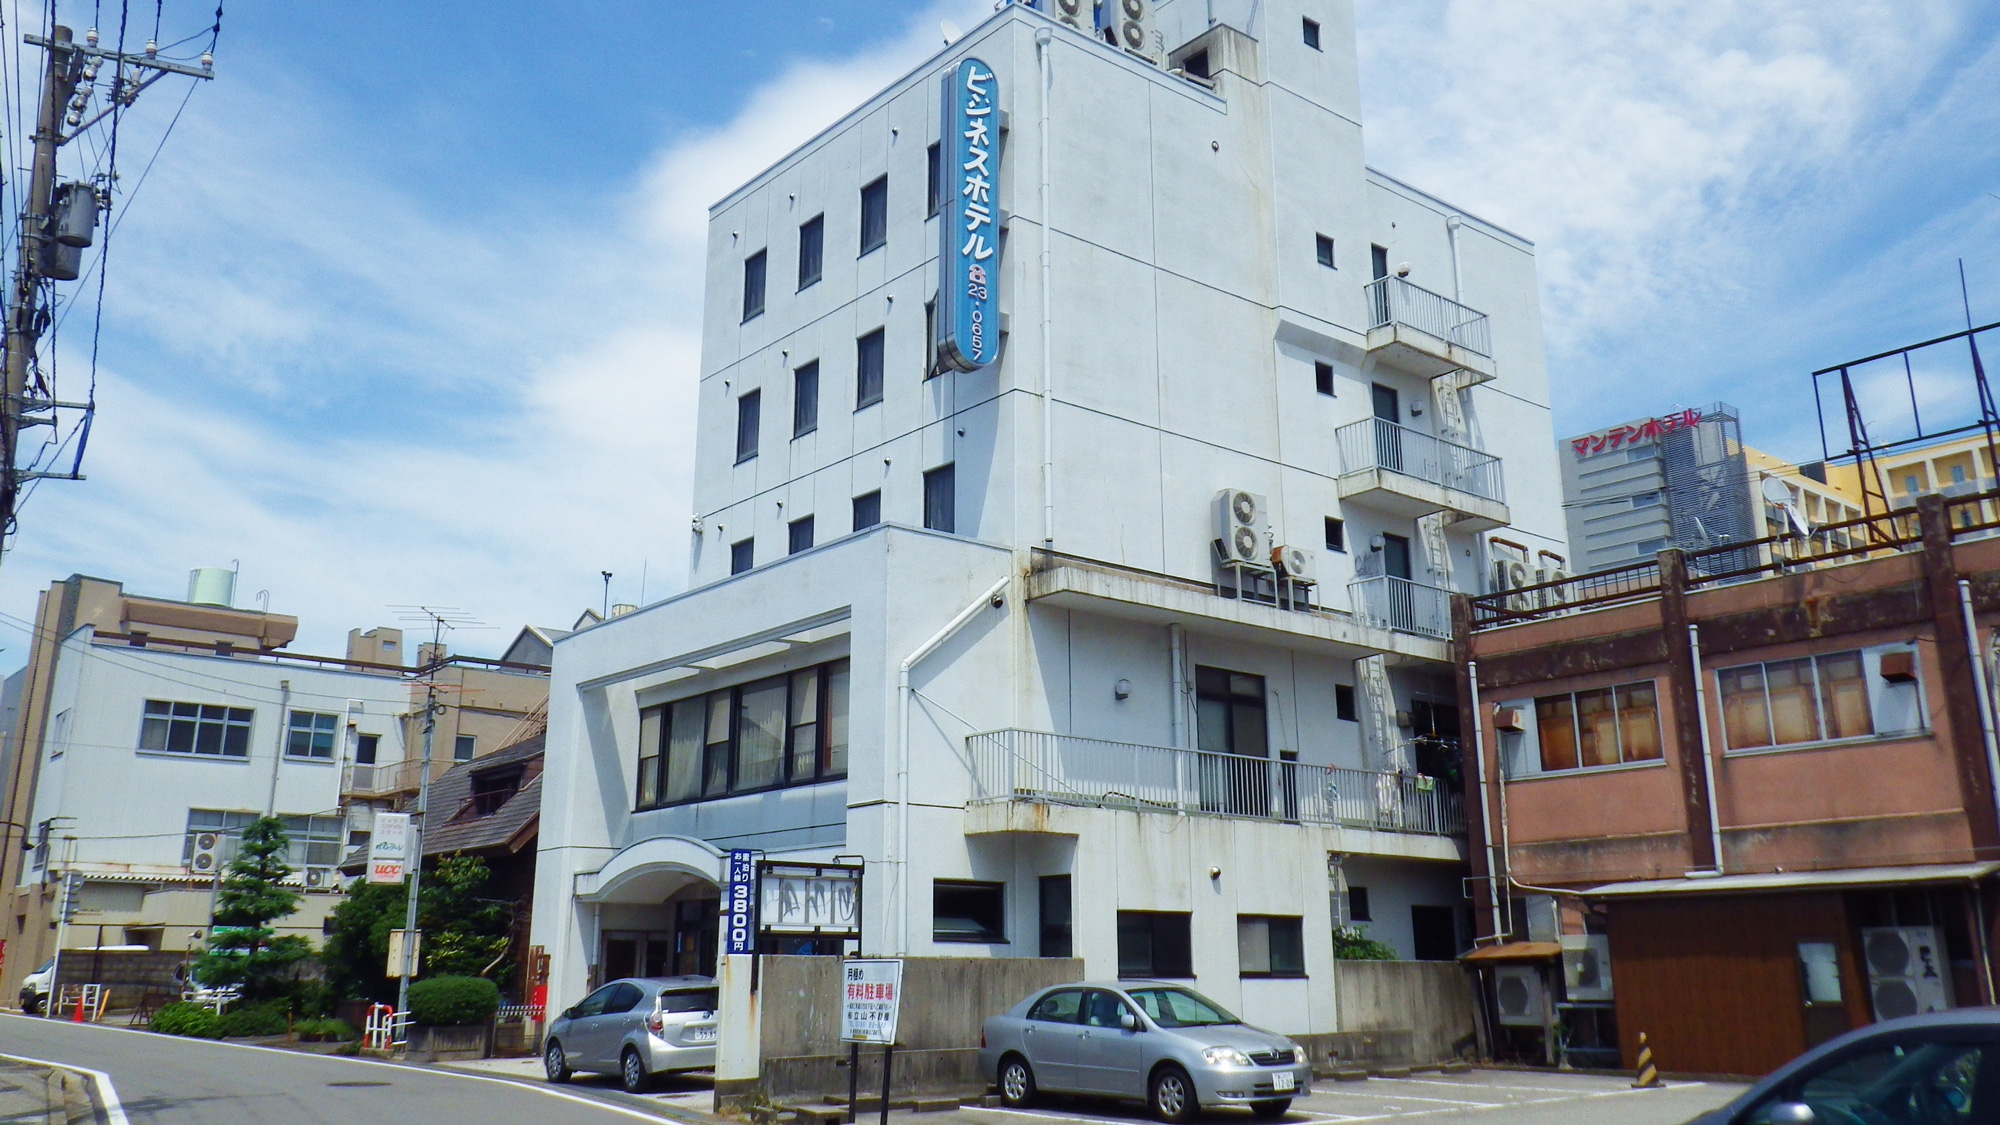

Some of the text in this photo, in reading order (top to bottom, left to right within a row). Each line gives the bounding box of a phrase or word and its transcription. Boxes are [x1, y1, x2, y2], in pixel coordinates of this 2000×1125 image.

[962, 65, 993, 260] ビジネスホテル
[1571, 408, 1702, 456] マンテンホテル
[374, 864, 402, 875] UCC
[732, 884, 748, 951] 3800円
[847, 968, 864, 981] 月極め
[847, 983, 893, 1000] 有料駐車場
